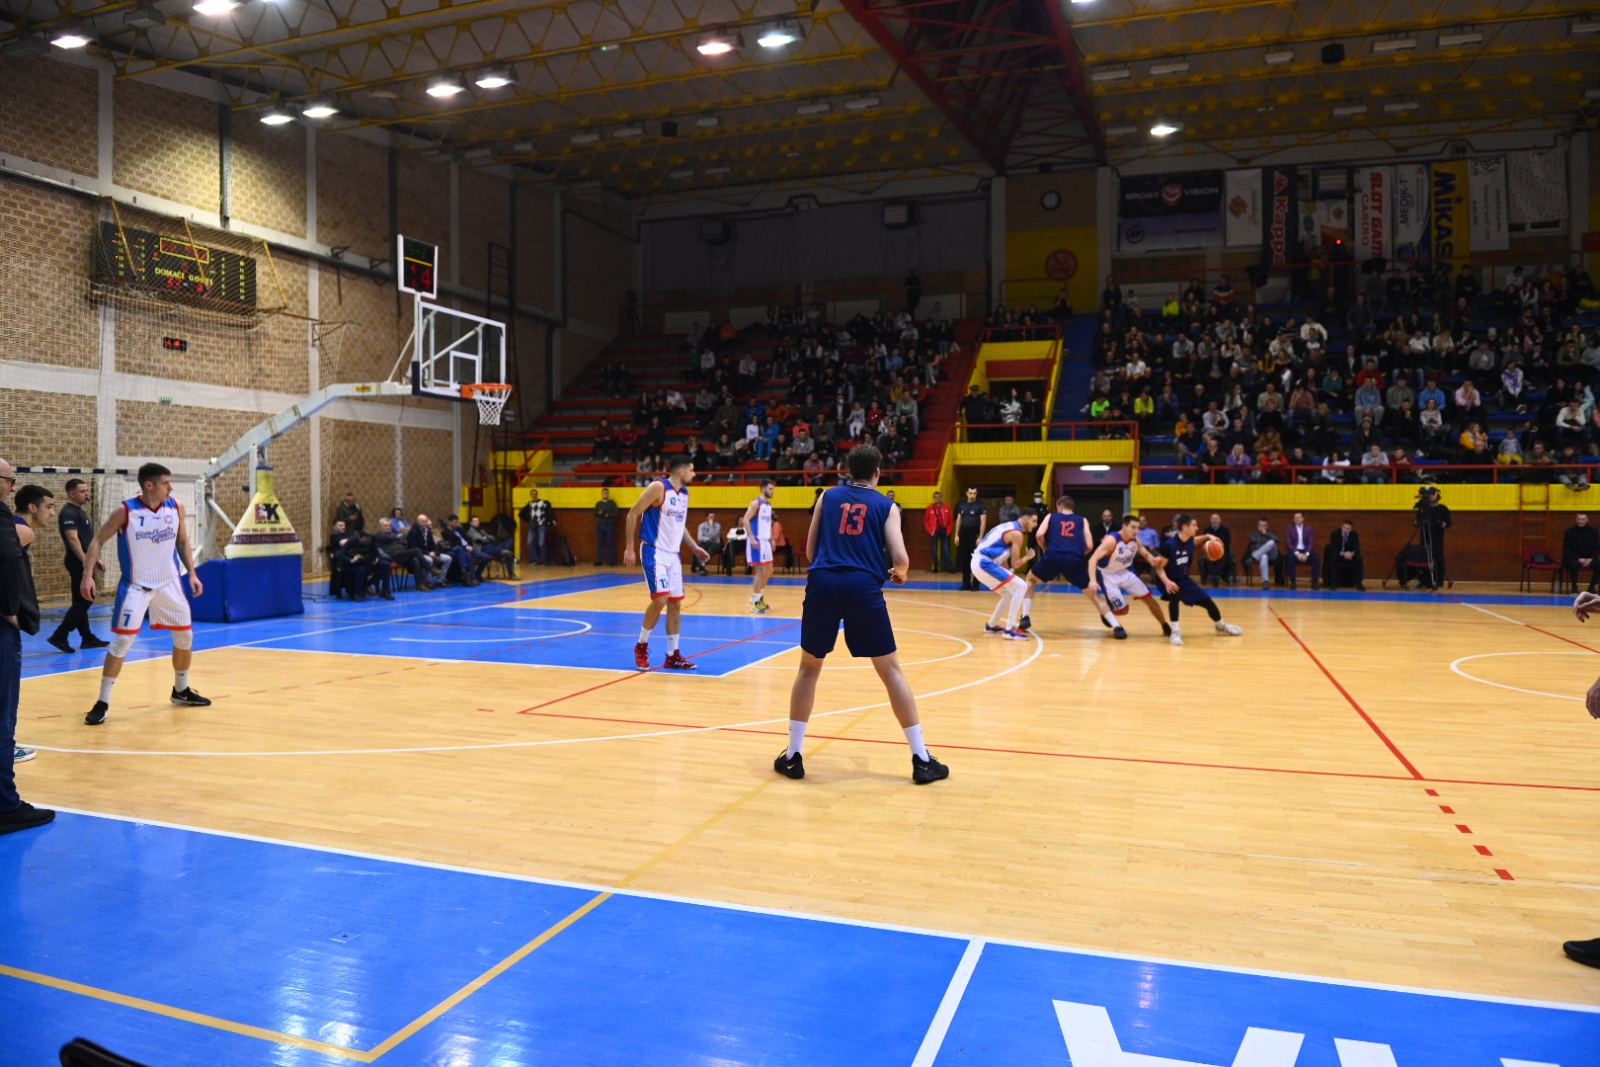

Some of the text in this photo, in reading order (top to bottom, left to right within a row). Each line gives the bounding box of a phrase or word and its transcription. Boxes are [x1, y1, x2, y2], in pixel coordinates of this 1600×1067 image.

[1125, 186, 1219, 201] SPORT VISION
[1361, 194, 1370, 246] CASINO
[1370, 171, 1383, 258] SLOT GAM
[1270, 195, 1288, 268] Kappa
[138, 516, 145, 527] 7
[838, 502, 868, 535] 13
[1060, 521, 1075, 537] 12
[123, 613, 131, 627] 7
